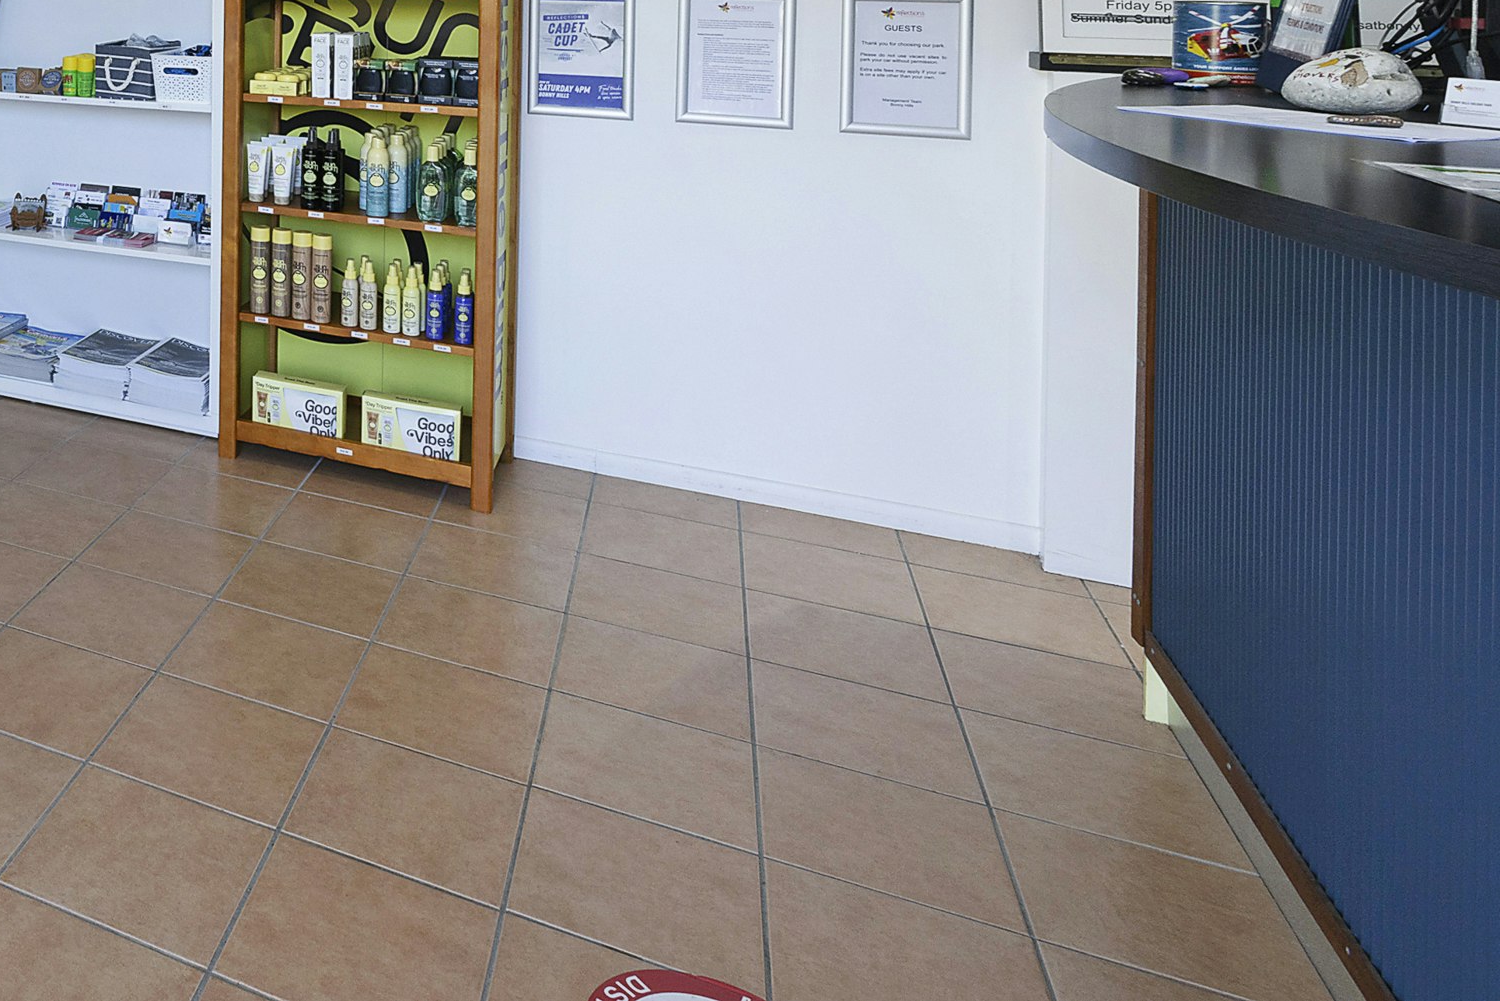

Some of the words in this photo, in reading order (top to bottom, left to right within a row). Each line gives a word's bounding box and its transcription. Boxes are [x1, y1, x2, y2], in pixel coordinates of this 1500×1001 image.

[1106, 0, 1150, 12] Friday
[1154, 0, 1172, 12] 5p
[548, 22, 585, 34] CADET
[555, 35, 578, 46] CUP
[539, 84, 574, 93] SATURDAY
[575, 85, 591, 93] 4PM
[418, 417, 454, 434] Good
[414, 431, 454, 447] Vibes
